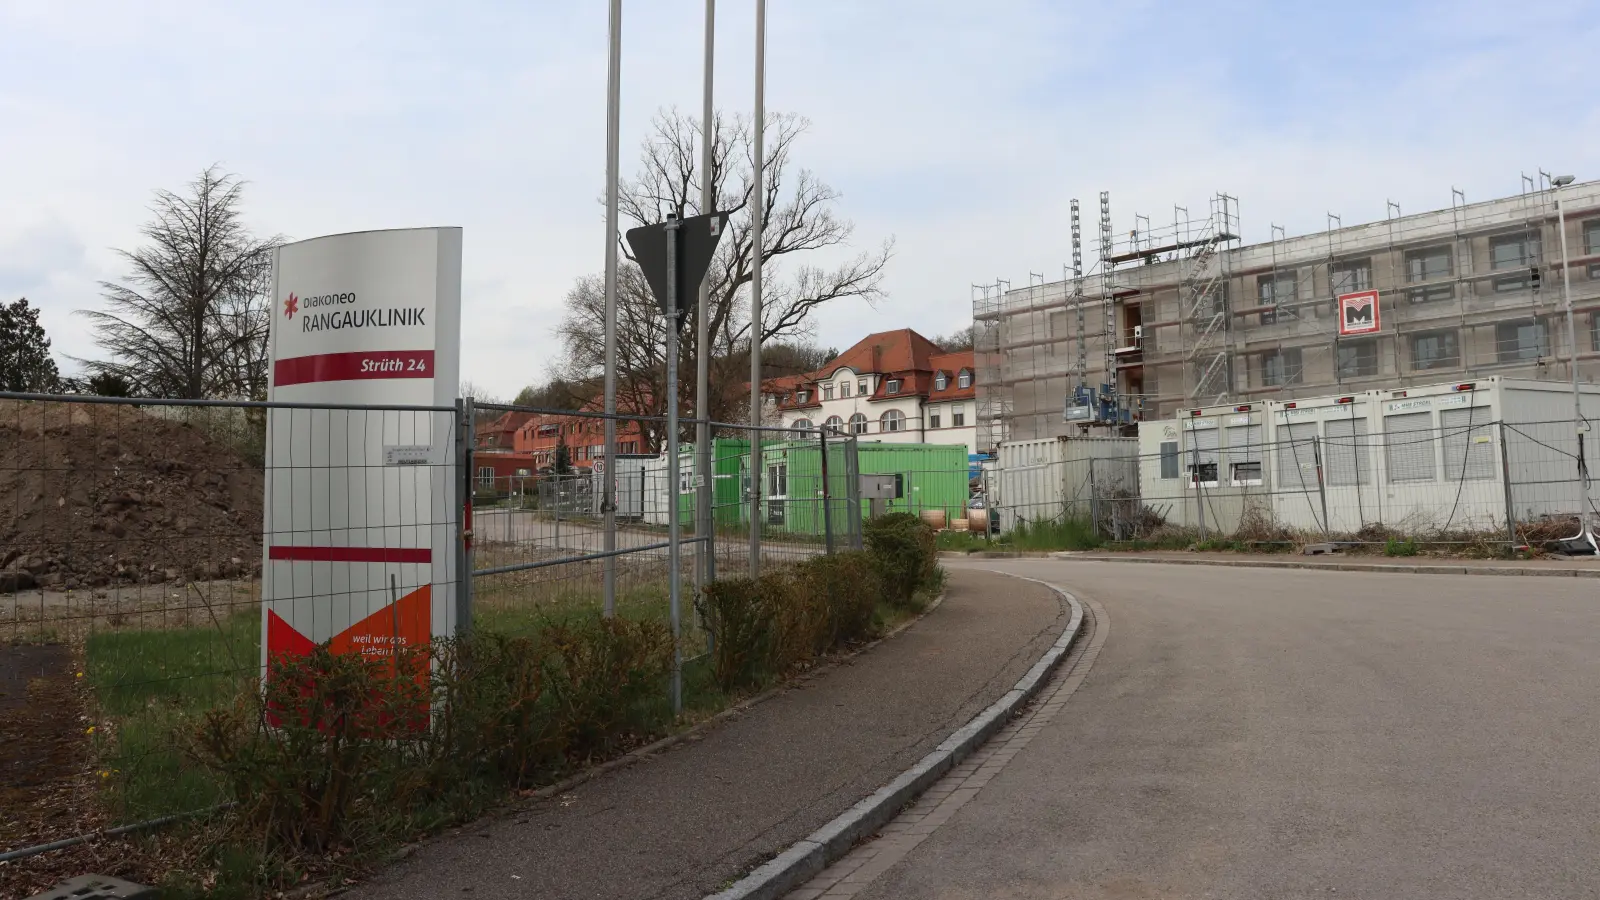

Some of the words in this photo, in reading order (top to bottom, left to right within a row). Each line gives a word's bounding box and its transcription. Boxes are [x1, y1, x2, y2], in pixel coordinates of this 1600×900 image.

[302, 307, 426, 333] RANGAUKLINIK
[361, 358, 404, 373] Strüth
[407, 358, 426, 372] 24
[352, 634, 371, 644] weil
[373, 634, 388, 644] wir
